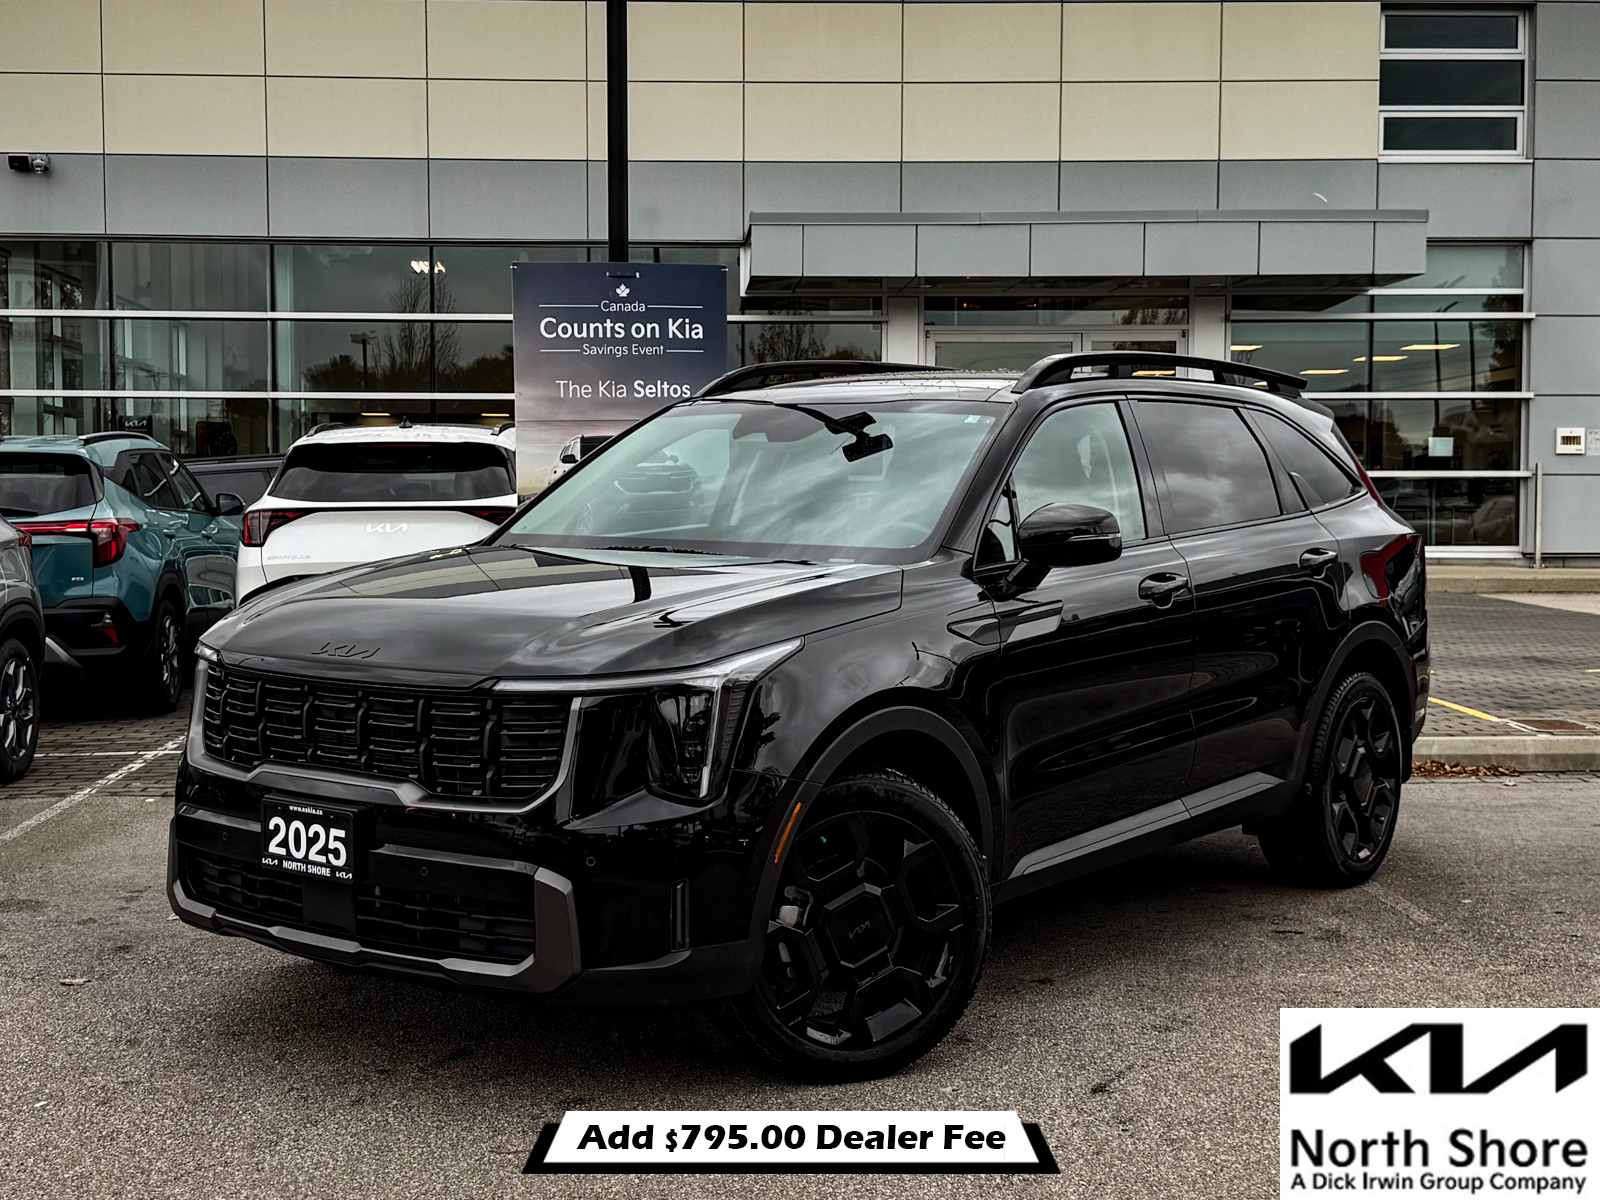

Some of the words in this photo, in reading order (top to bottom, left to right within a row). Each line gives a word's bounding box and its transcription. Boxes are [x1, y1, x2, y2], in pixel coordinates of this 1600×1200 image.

[600, 300, 646, 312] Canada
[539, 317, 625, 338] Counts
[631, 322, 660, 338] on
[668, 318, 704, 339] Kia
[582, 343, 629, 357] Savings
[632, 344, 664, 355] Event
[556, 380, 592, 398] The
[598, 380, 627, 398] Kia
[633, 379, 691, 398] Seltos
[366, 523, 408, 533] KIA
[310, 641, 381, 659] KIA
[268, 816, 347, 867] 2025
[262, 857, 278, 866] KIA
[282, 860, 307, 872] NORTH
[307, 864, 331, 877] SHORE
[335, 871, 353, 879] KIA
